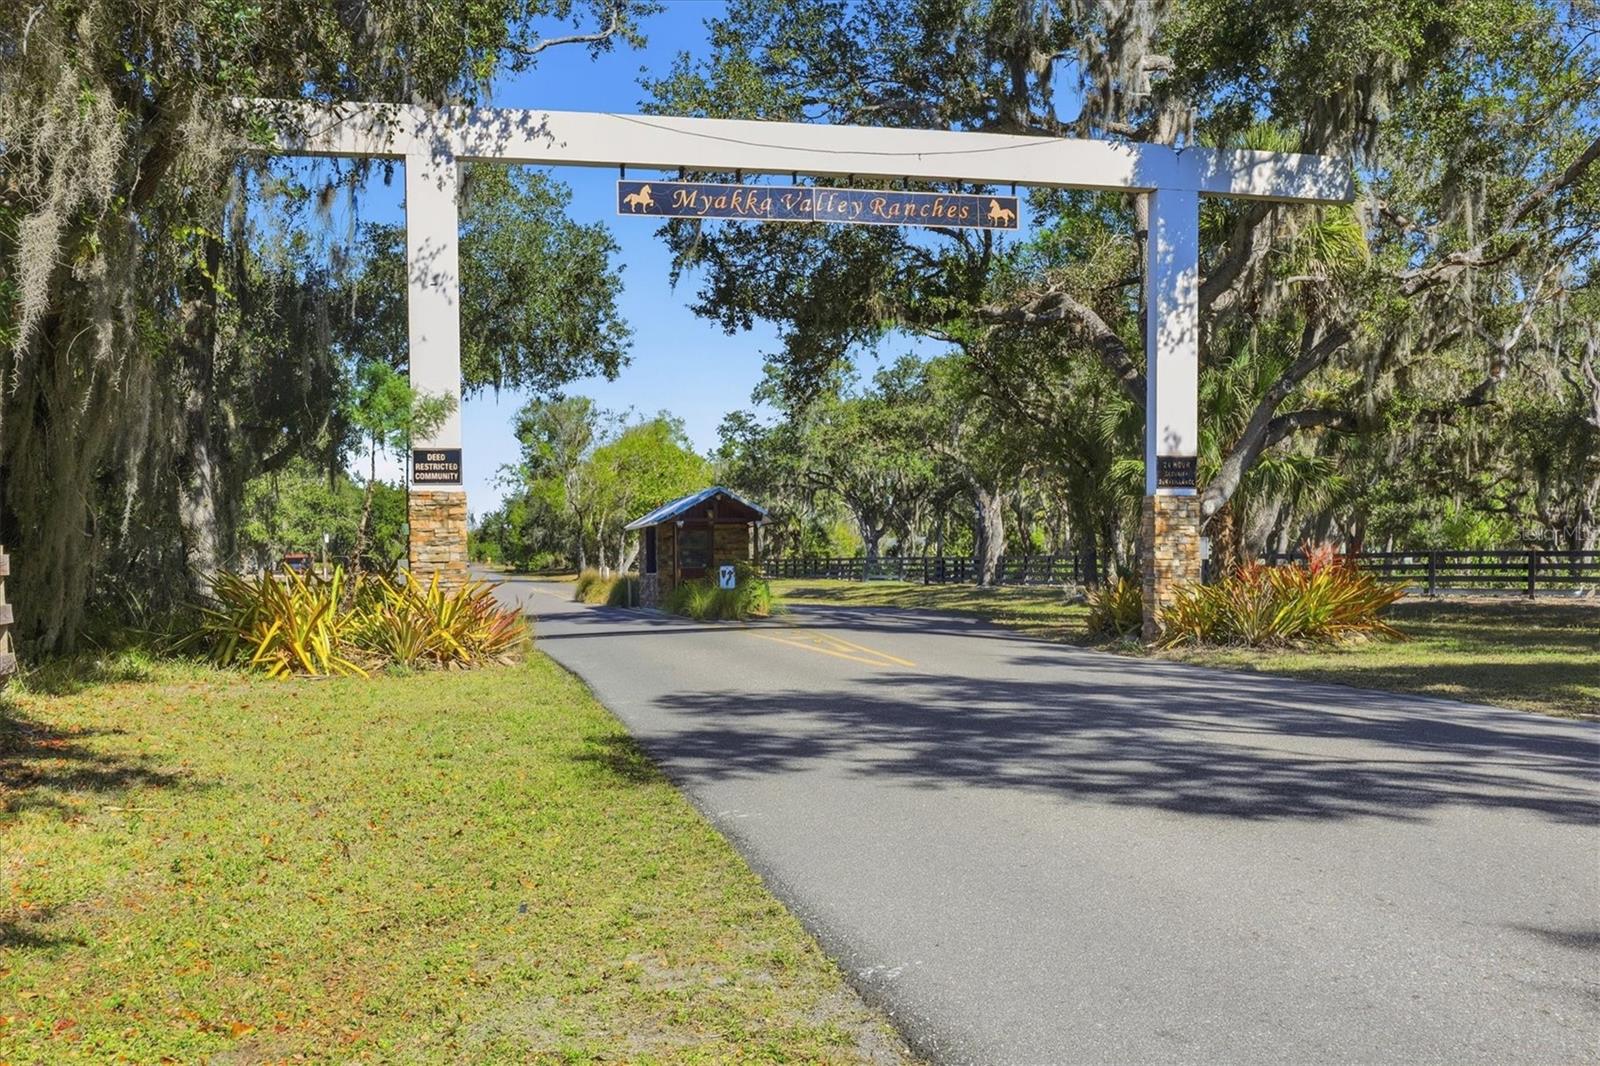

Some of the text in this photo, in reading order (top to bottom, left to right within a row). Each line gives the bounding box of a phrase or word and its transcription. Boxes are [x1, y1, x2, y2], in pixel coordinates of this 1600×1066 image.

[672, 189, 970, 220] Myakka Valley Ranches
[427, 453, 446, 461] DEED
[415, 463, 458, 471] RESTRICTED
[415, 472, 459, 480] COMMUNITY
